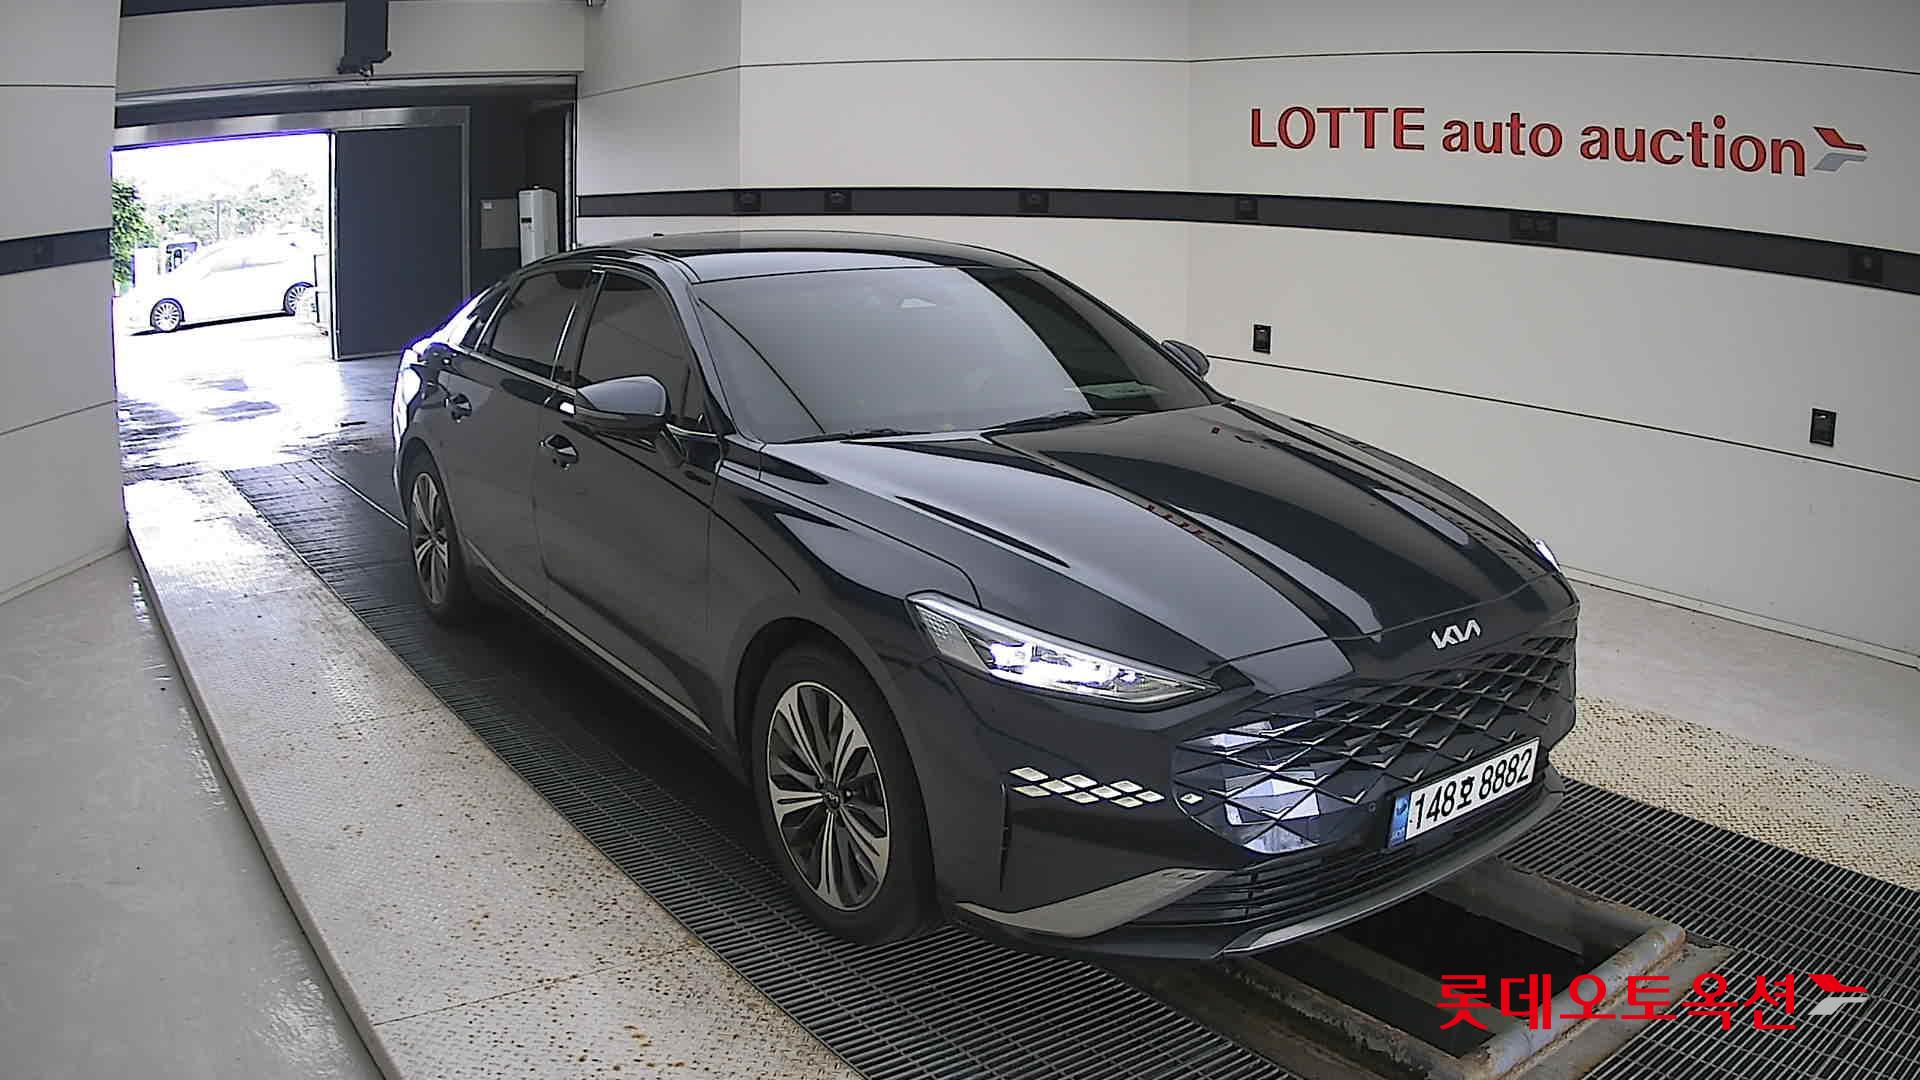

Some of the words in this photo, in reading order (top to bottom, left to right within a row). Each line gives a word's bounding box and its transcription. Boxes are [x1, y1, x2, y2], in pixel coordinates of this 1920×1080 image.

[1250, 106, 1426, 151] LOTTE
[1441, 112, 1564, 158] auto
[1579, 115, 1807, 177] auction
[1415, 776, 1475, 830] 148호
[1478, 748, 1533, 800] 8882
